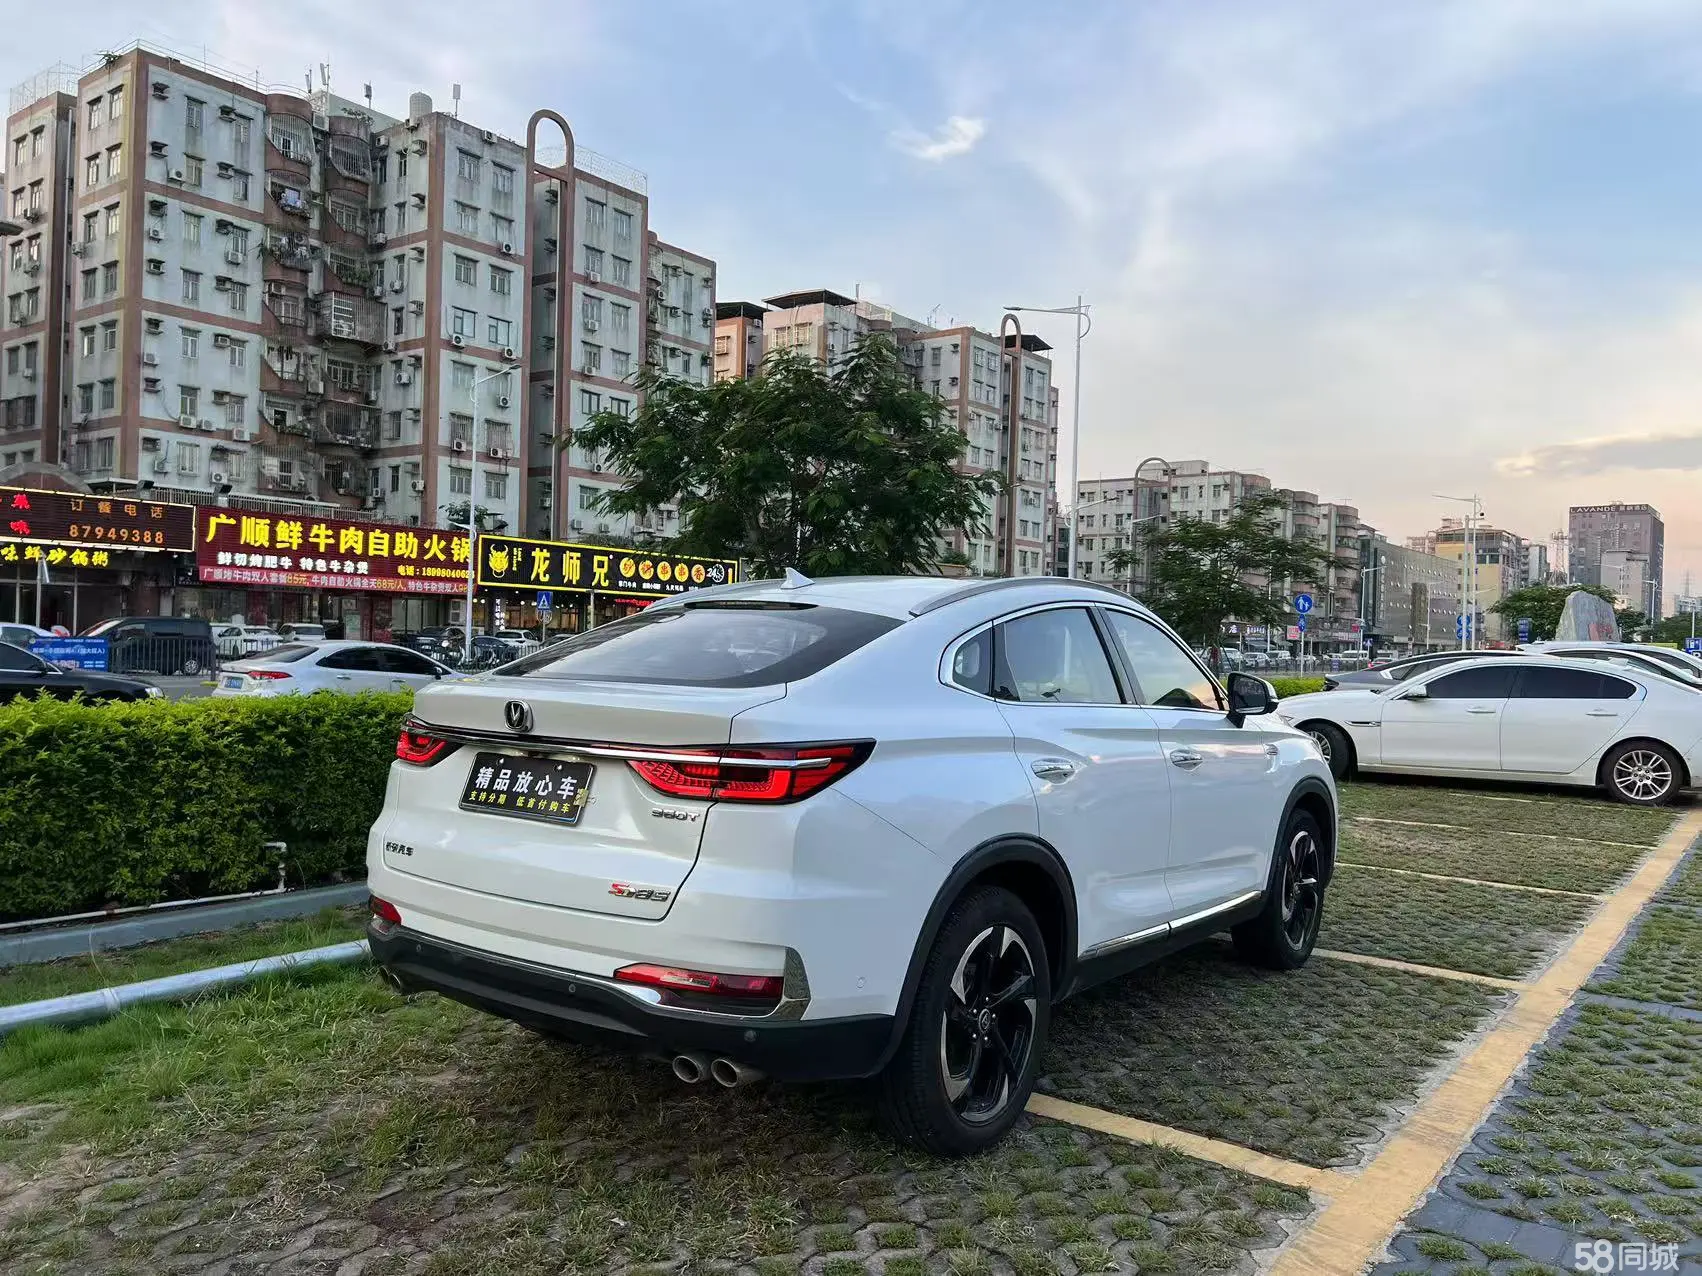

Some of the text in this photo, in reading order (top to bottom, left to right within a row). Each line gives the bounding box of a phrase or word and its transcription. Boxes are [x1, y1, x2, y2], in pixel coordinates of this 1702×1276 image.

[70, 499, 163, 518] 订餐电话
[69, 524, 164, 544] 87949388
[205, 513, 471, 563] 广顺鲜牛肉自助火锅
[531, 547, 609, 587] 龙师兄
[475, 767, 577, 800] 精品放心车
[469, 790, 571, 814] 支持分期 低首付购车
